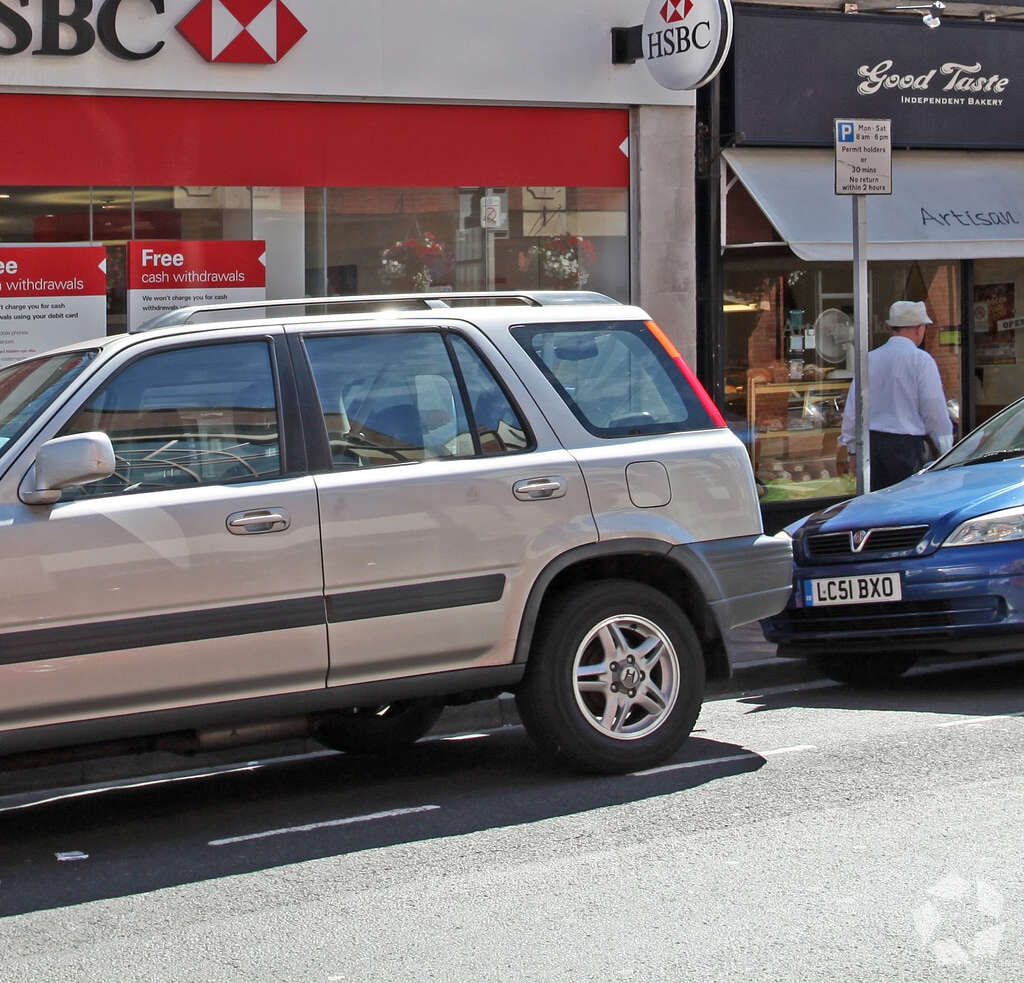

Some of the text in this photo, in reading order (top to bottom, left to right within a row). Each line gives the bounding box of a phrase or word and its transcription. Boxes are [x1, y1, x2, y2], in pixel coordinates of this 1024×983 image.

[647, 21, 711, 60] HSBC
[857, 60, 1009, 95] Good Taste
[901, 95, 1003, 106] INDEPENDENT BAKERY
[841, 124, 852, 141] P
[920, 207, 1020, 226] Artisan
[141, 248, 184, 267] Free
[6, 277, 84, 291] withdrawals
[141, 270, 245, 283] cash withdrawals
[5, 303, 26, 311] charge
